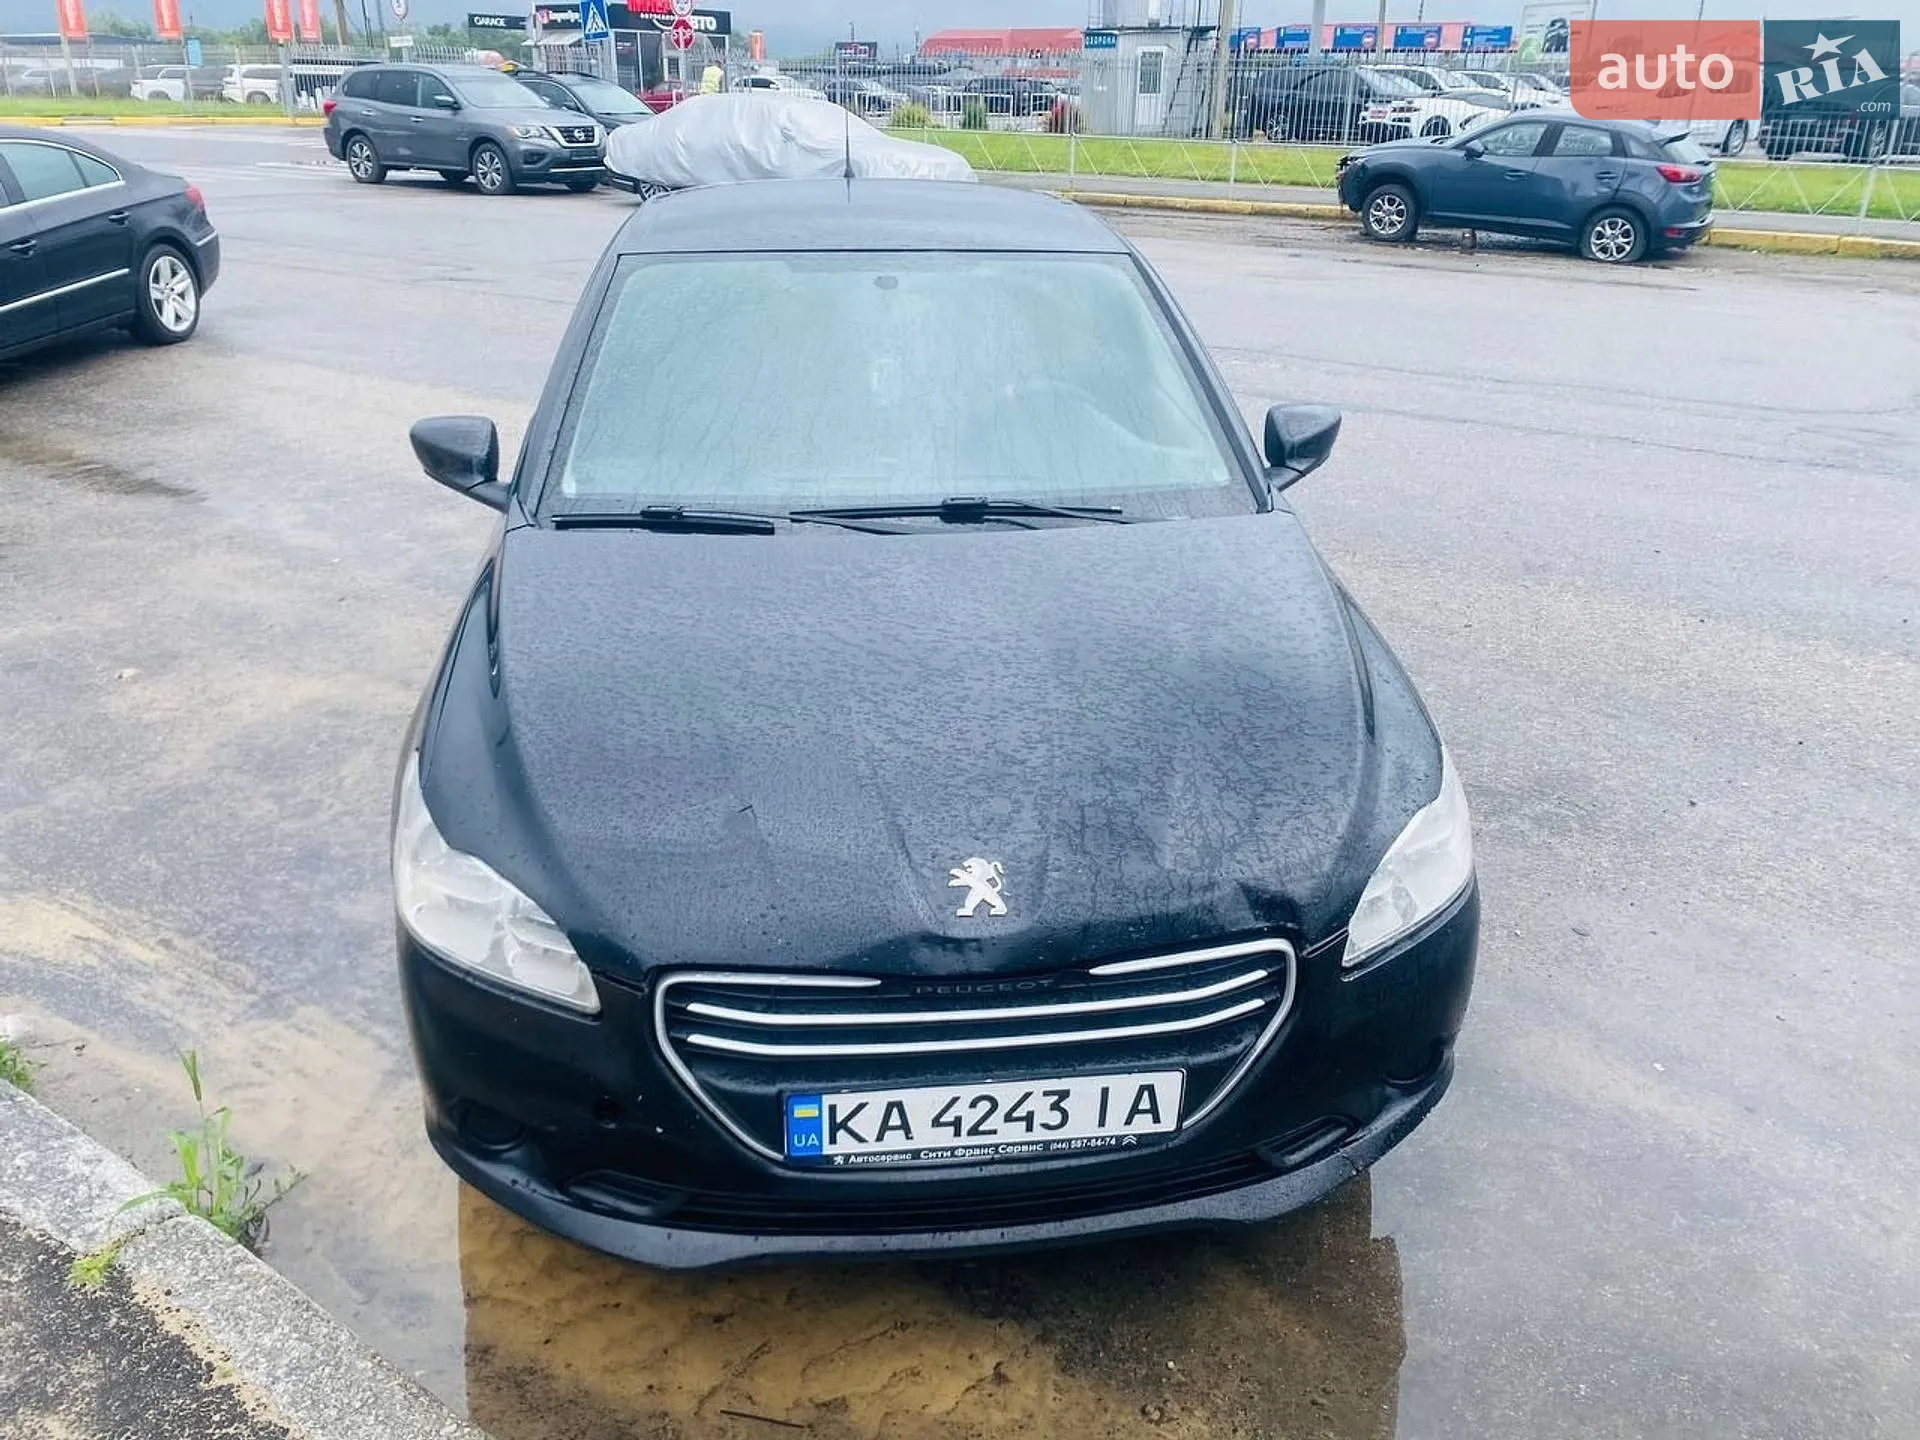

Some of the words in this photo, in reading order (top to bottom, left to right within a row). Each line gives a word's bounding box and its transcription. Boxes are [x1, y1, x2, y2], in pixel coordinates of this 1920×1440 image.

[828, 1100, 914, 1145] KA
[931, 1088, 1070, 1138] 4243
[1097, 1083, 1161, 1128] IA
[793, 1134, 819, 1147] UA
[848, 1153, 912, 1165] Автосервис
[920, 1149, 951, 1160] Сити
[955, 1145, 996, 1158] Франс
[998, 1142, 1044, 1154] Сервис
